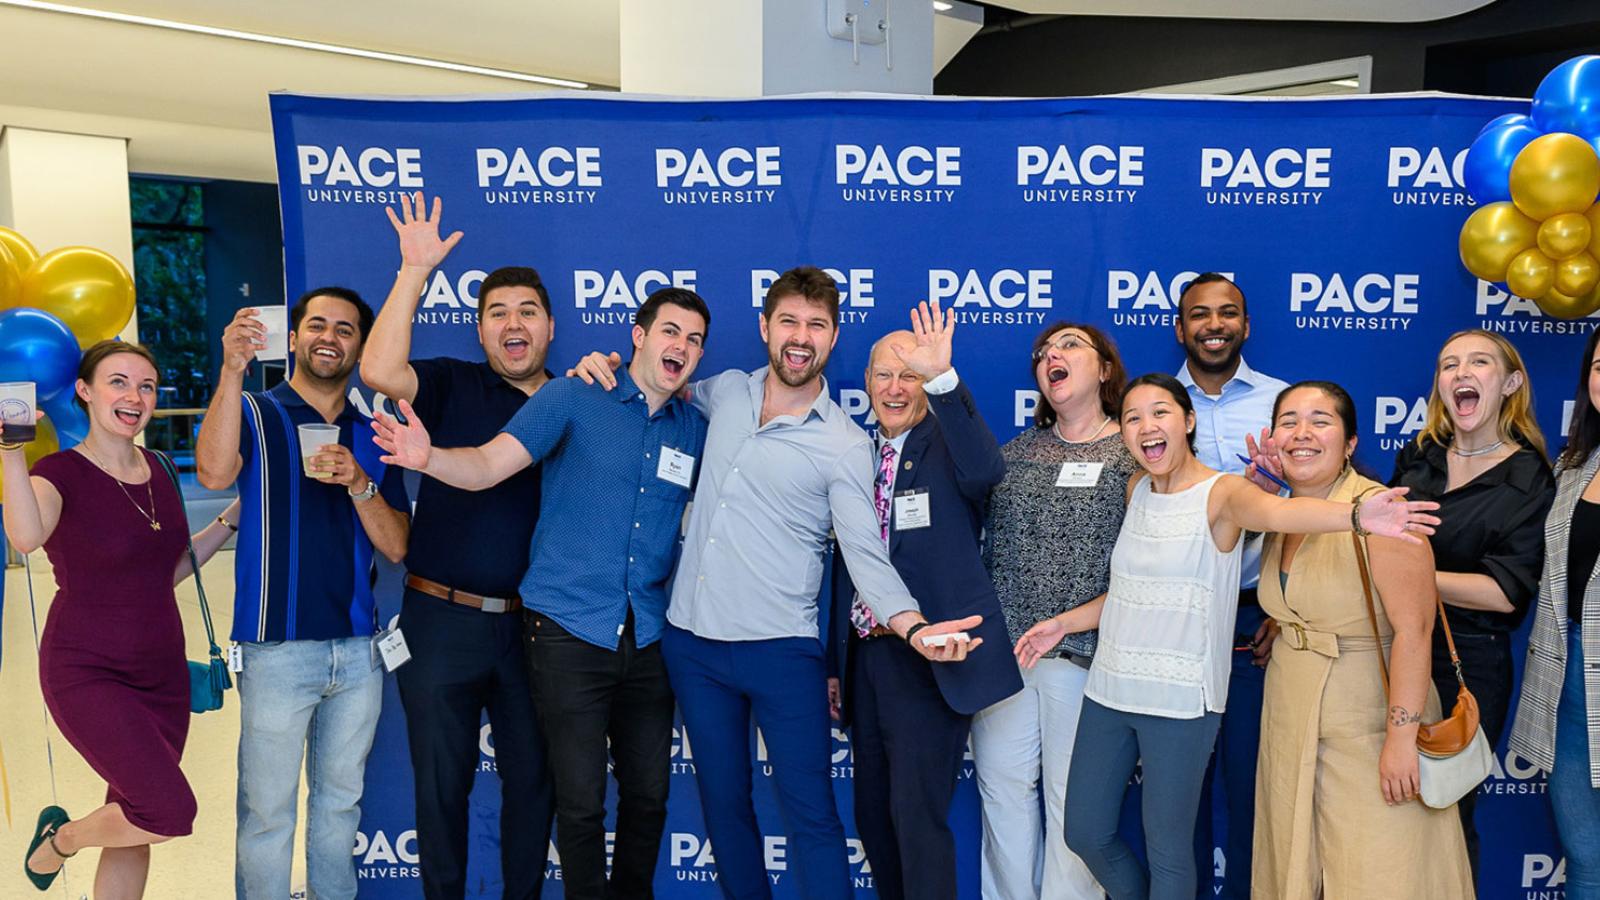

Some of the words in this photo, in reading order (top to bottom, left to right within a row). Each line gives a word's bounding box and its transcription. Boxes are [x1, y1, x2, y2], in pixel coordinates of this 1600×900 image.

[297, 145, 424, 187] PACE
[476, 147, 602, 187] PACE
[656, 146, 782, 187] PACE
[836, 144, 961, 186] PACE
[1017, 145, 1144, 186] PACE
[1200, 148, 1333, 188] PACE
[1388, 147, 1470, 188] PA
[486, 191, 596, 204] UNIVERSITY
[664, 190, 776, 204] UNIVERSITY
[843, 189, 955, 202] UNIVERSITY
[1023, 189, 1137, 203] UNIVERSITY
[1206, 192, 1323, 205] UNIVERSITY
[1393, 192, 1477, 206] UNIVER
[928, 269, 1053, 308] PACE
[1290, 273, 1419, 313] PACE
[582, 312, 636, 324] UNIVE
[1296, 317, 1411, 330] UNIVERSITY
[1482, 320, 1599, 334] UNIVERSITY
[1374, 396, 1428, 434] PA
[358, 867, 421, 878] NIVERS
[1522, 854, 1567, 887] PA
